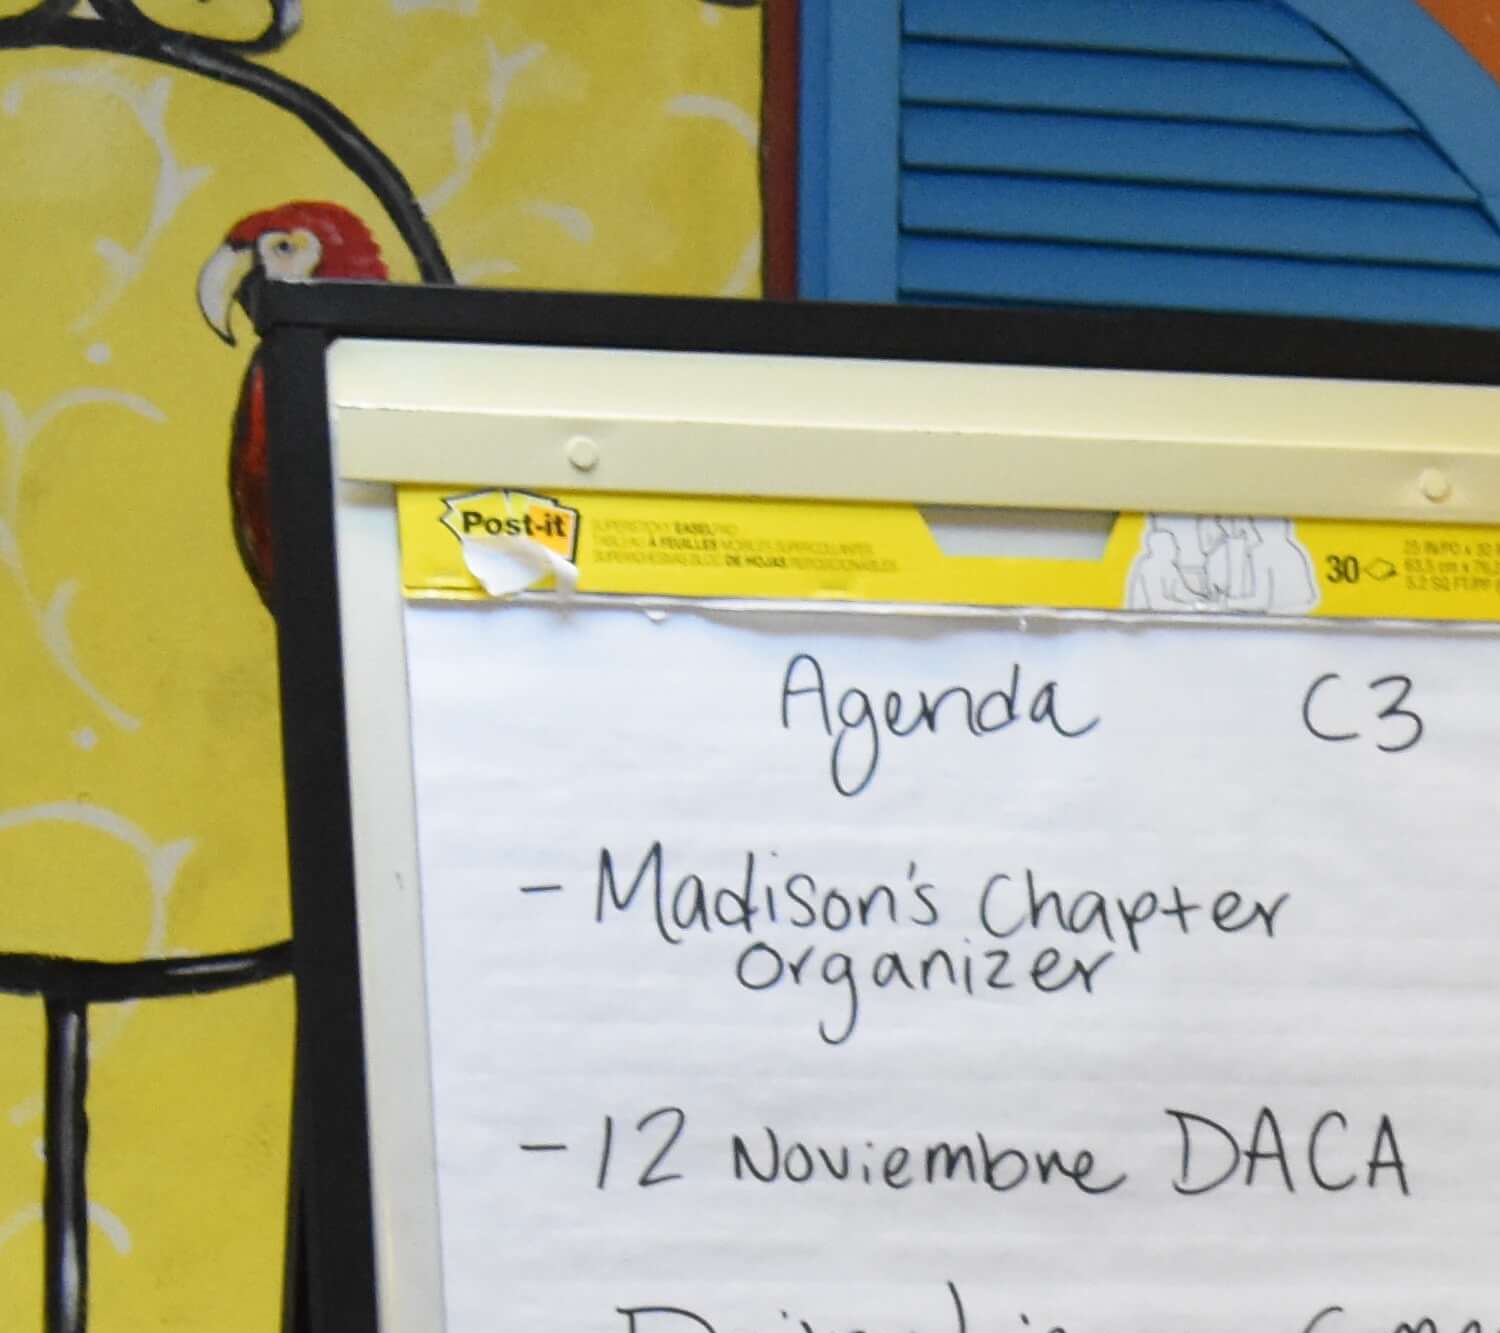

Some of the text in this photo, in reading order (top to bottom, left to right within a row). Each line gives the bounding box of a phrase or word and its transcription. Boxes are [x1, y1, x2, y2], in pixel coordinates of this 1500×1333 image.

[461, 509, 568, 537] Post-it
[1326, 553, 1360, 585] 30
[780, 652, 1425, 799] Agenda C3
[594, 839, 940, 946] Madison's
[730, 1125, 1129, 1197] Noviembre
[1163, 1104, 1412, 1198] DACA
